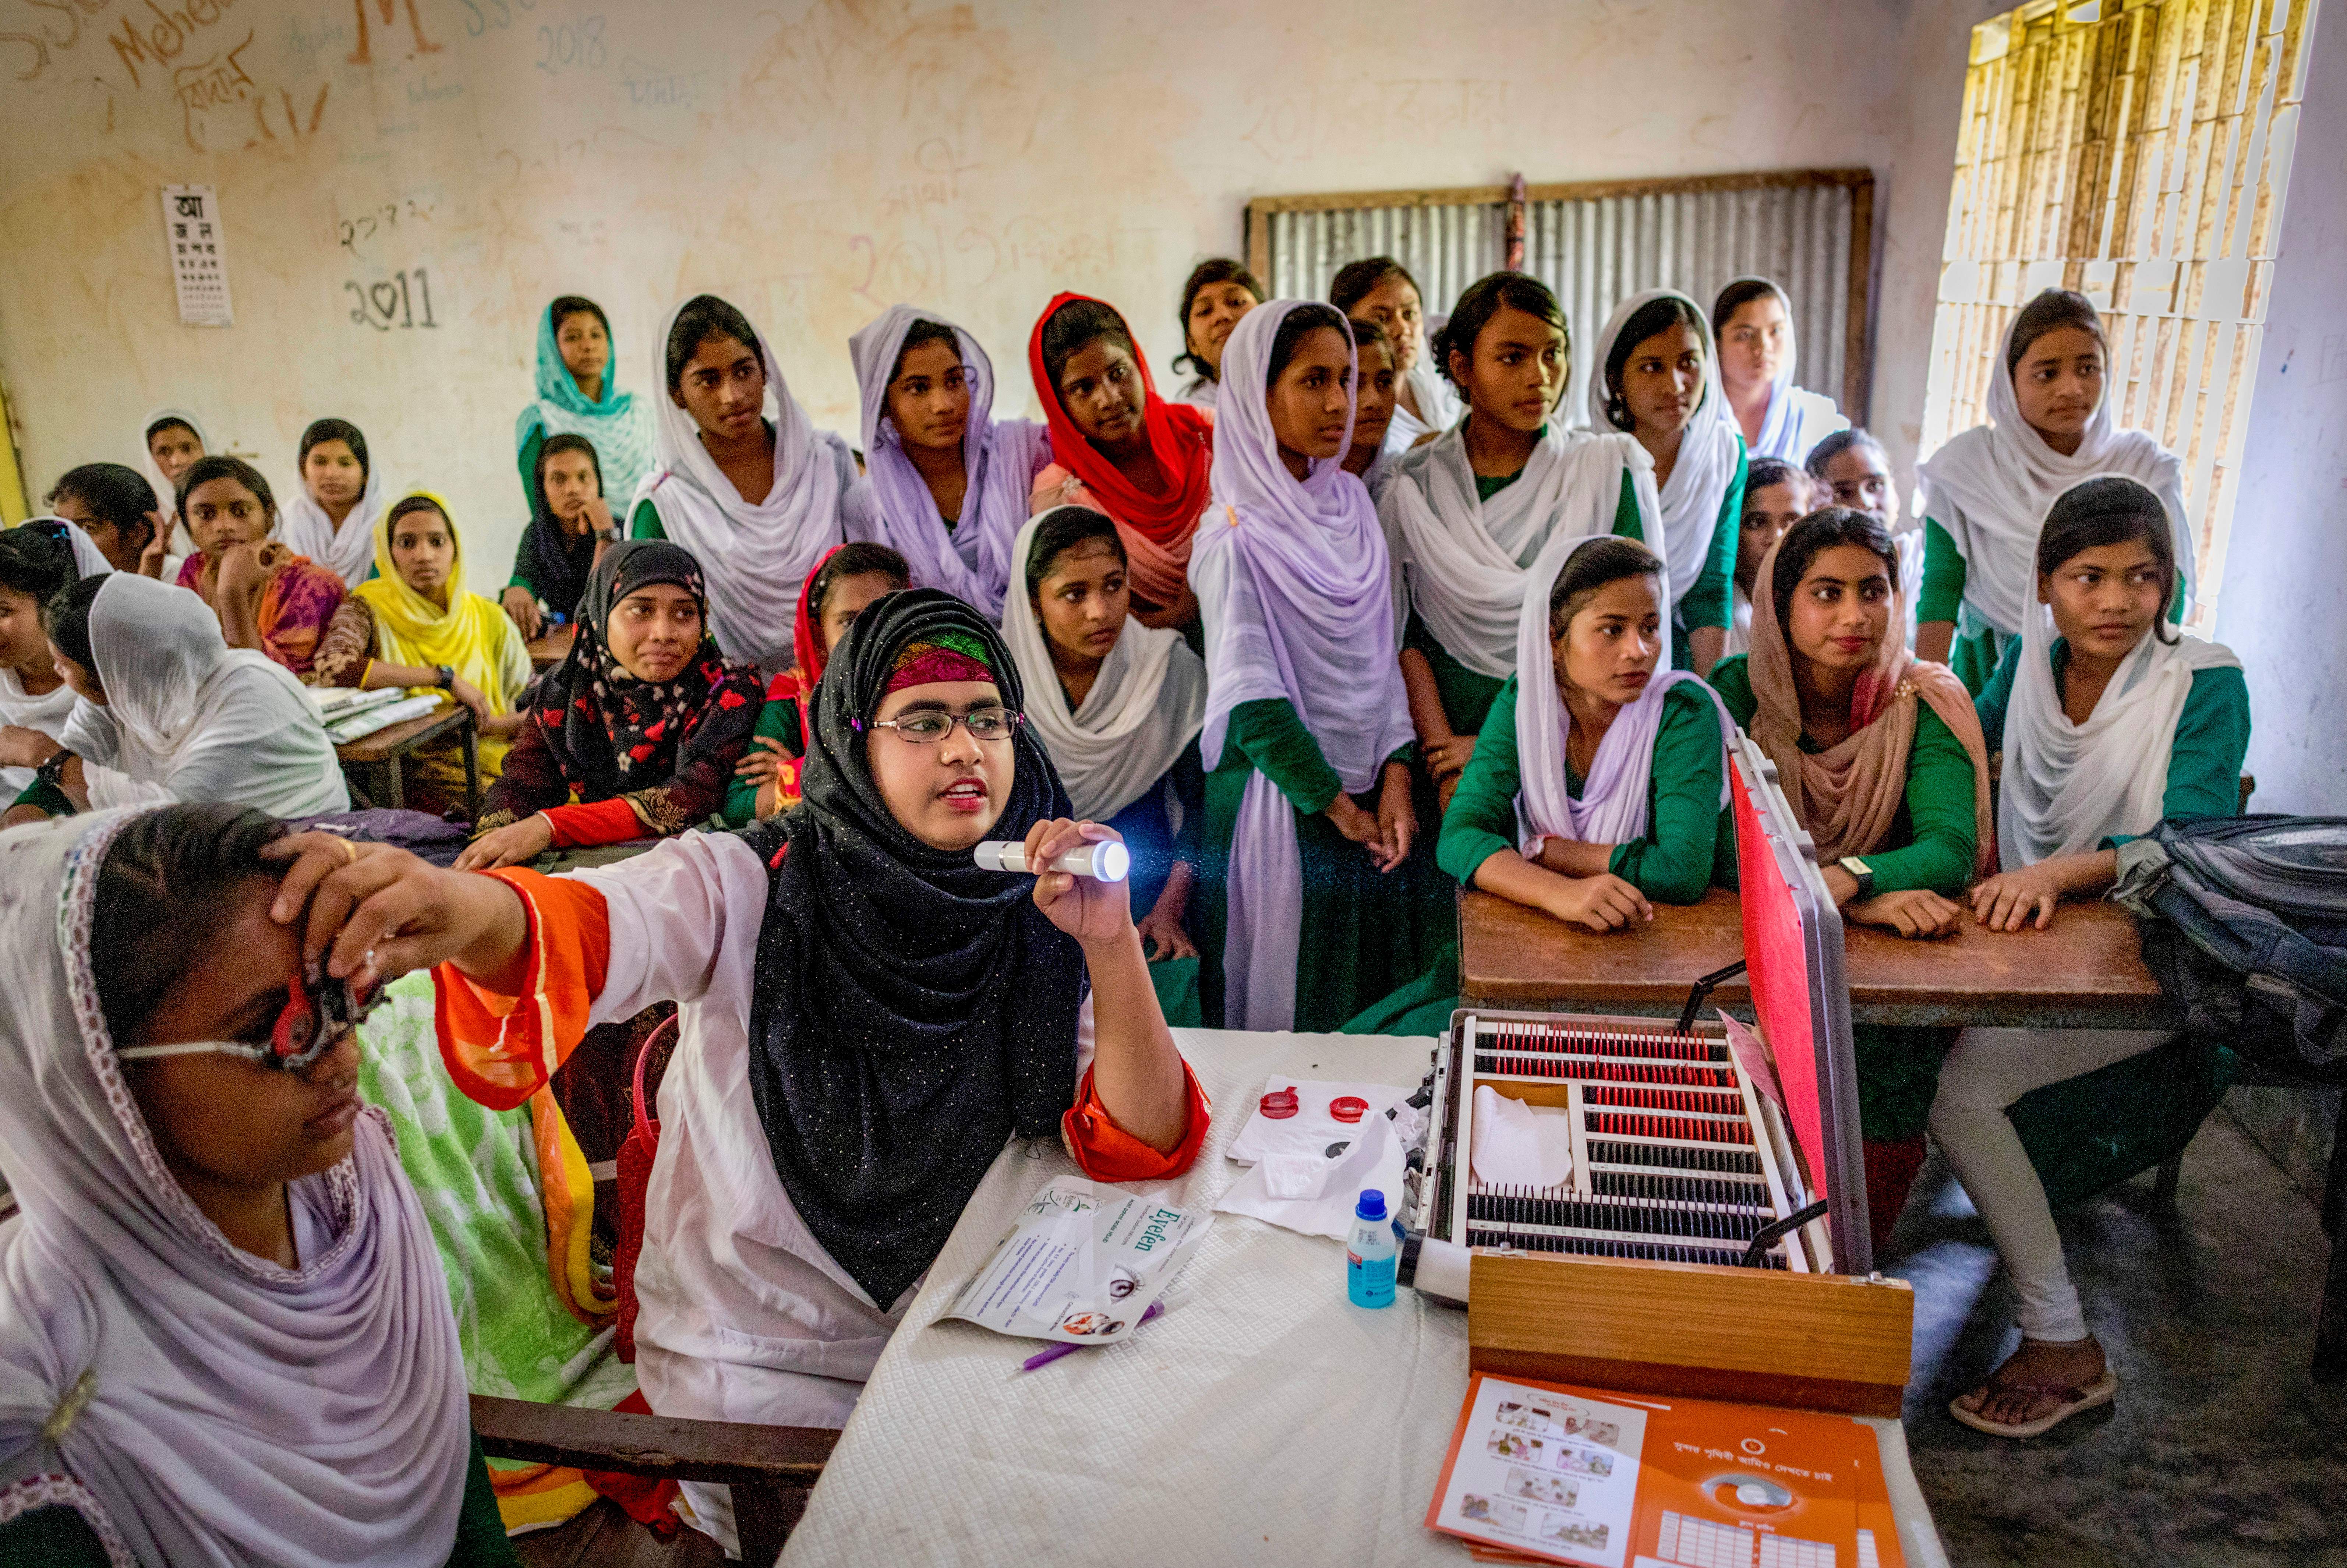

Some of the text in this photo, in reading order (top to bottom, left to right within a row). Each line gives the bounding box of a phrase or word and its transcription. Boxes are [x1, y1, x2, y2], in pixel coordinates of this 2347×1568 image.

[108, 0, 233, 89] Mehe
[536, 12, 609, 75] 2018
[174, 195, 204, 219] আ
[1110, 1220, 1120, 1231] ocular
[1118, 1208, 1128, 1220] potent
[1102, 1231, 1113, 1243] NSAID
[1135, 1208, 1181, 1251] Eyefen
[1704, 1448, 1735, 1461] পৃথিবী
[1775, 1464, 1810, 1477] দেখতে
[1814, 1472, 1833, 1483] চাই
